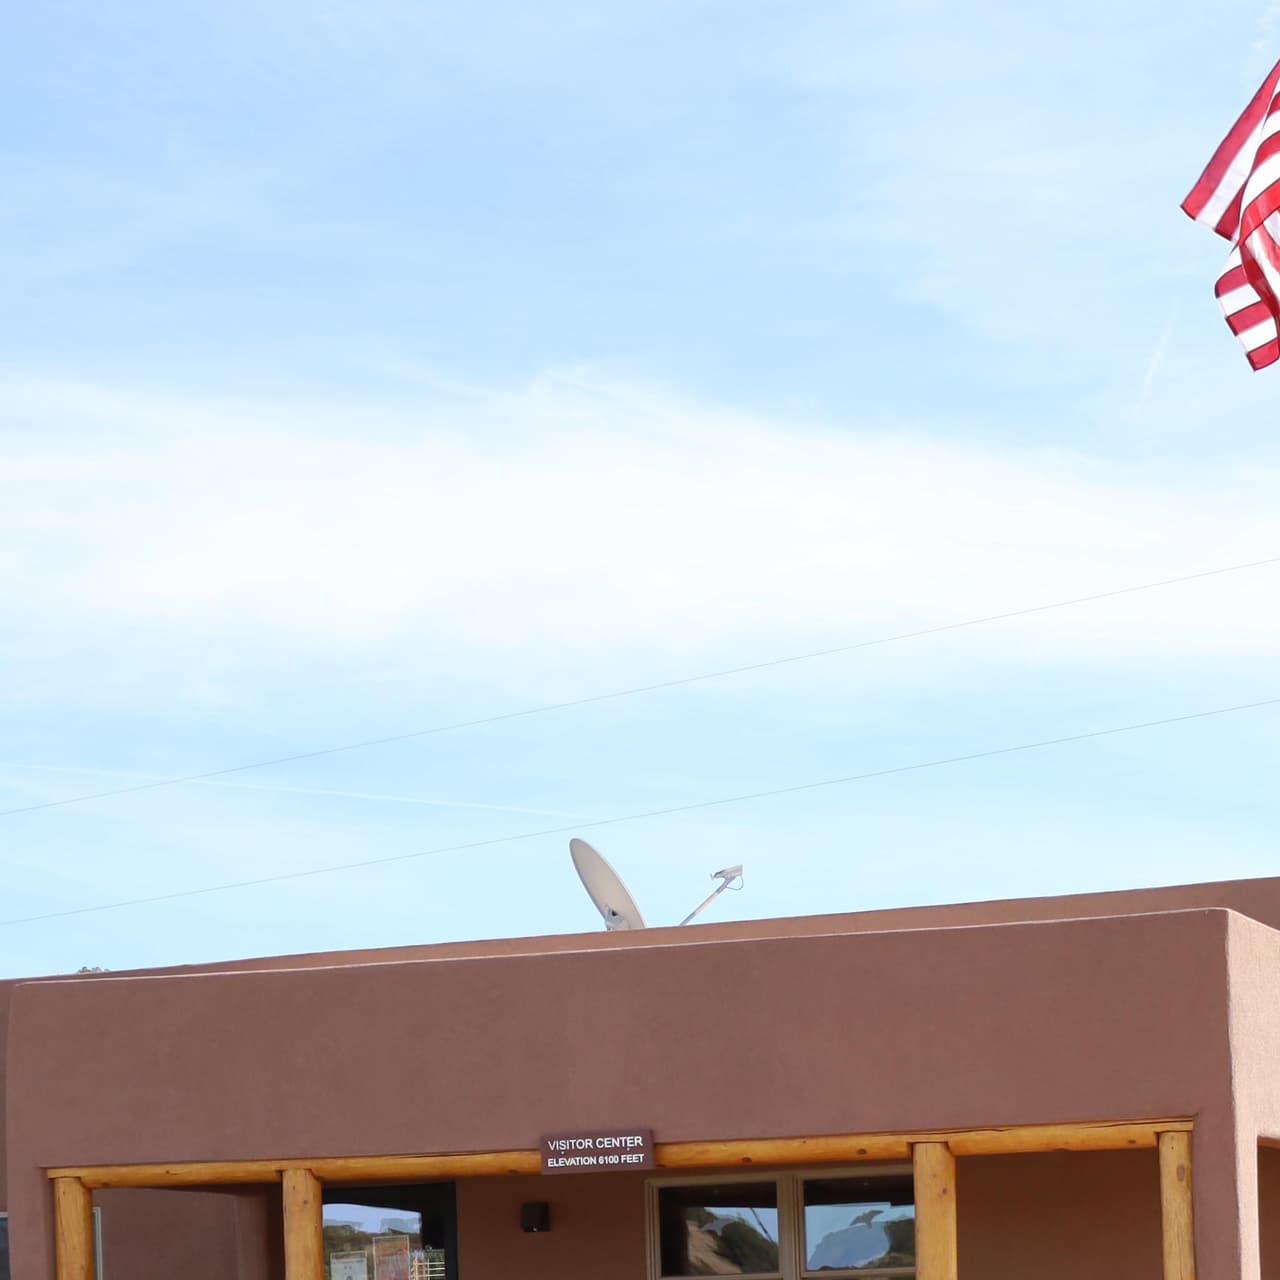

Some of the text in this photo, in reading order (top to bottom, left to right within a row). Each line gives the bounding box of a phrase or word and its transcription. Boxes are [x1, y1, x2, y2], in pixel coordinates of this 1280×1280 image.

[548, 1136, 643, 1151] VISITOR CENTER
[547, 1154, 645, 1167] ELEVATION 6100 FEET
